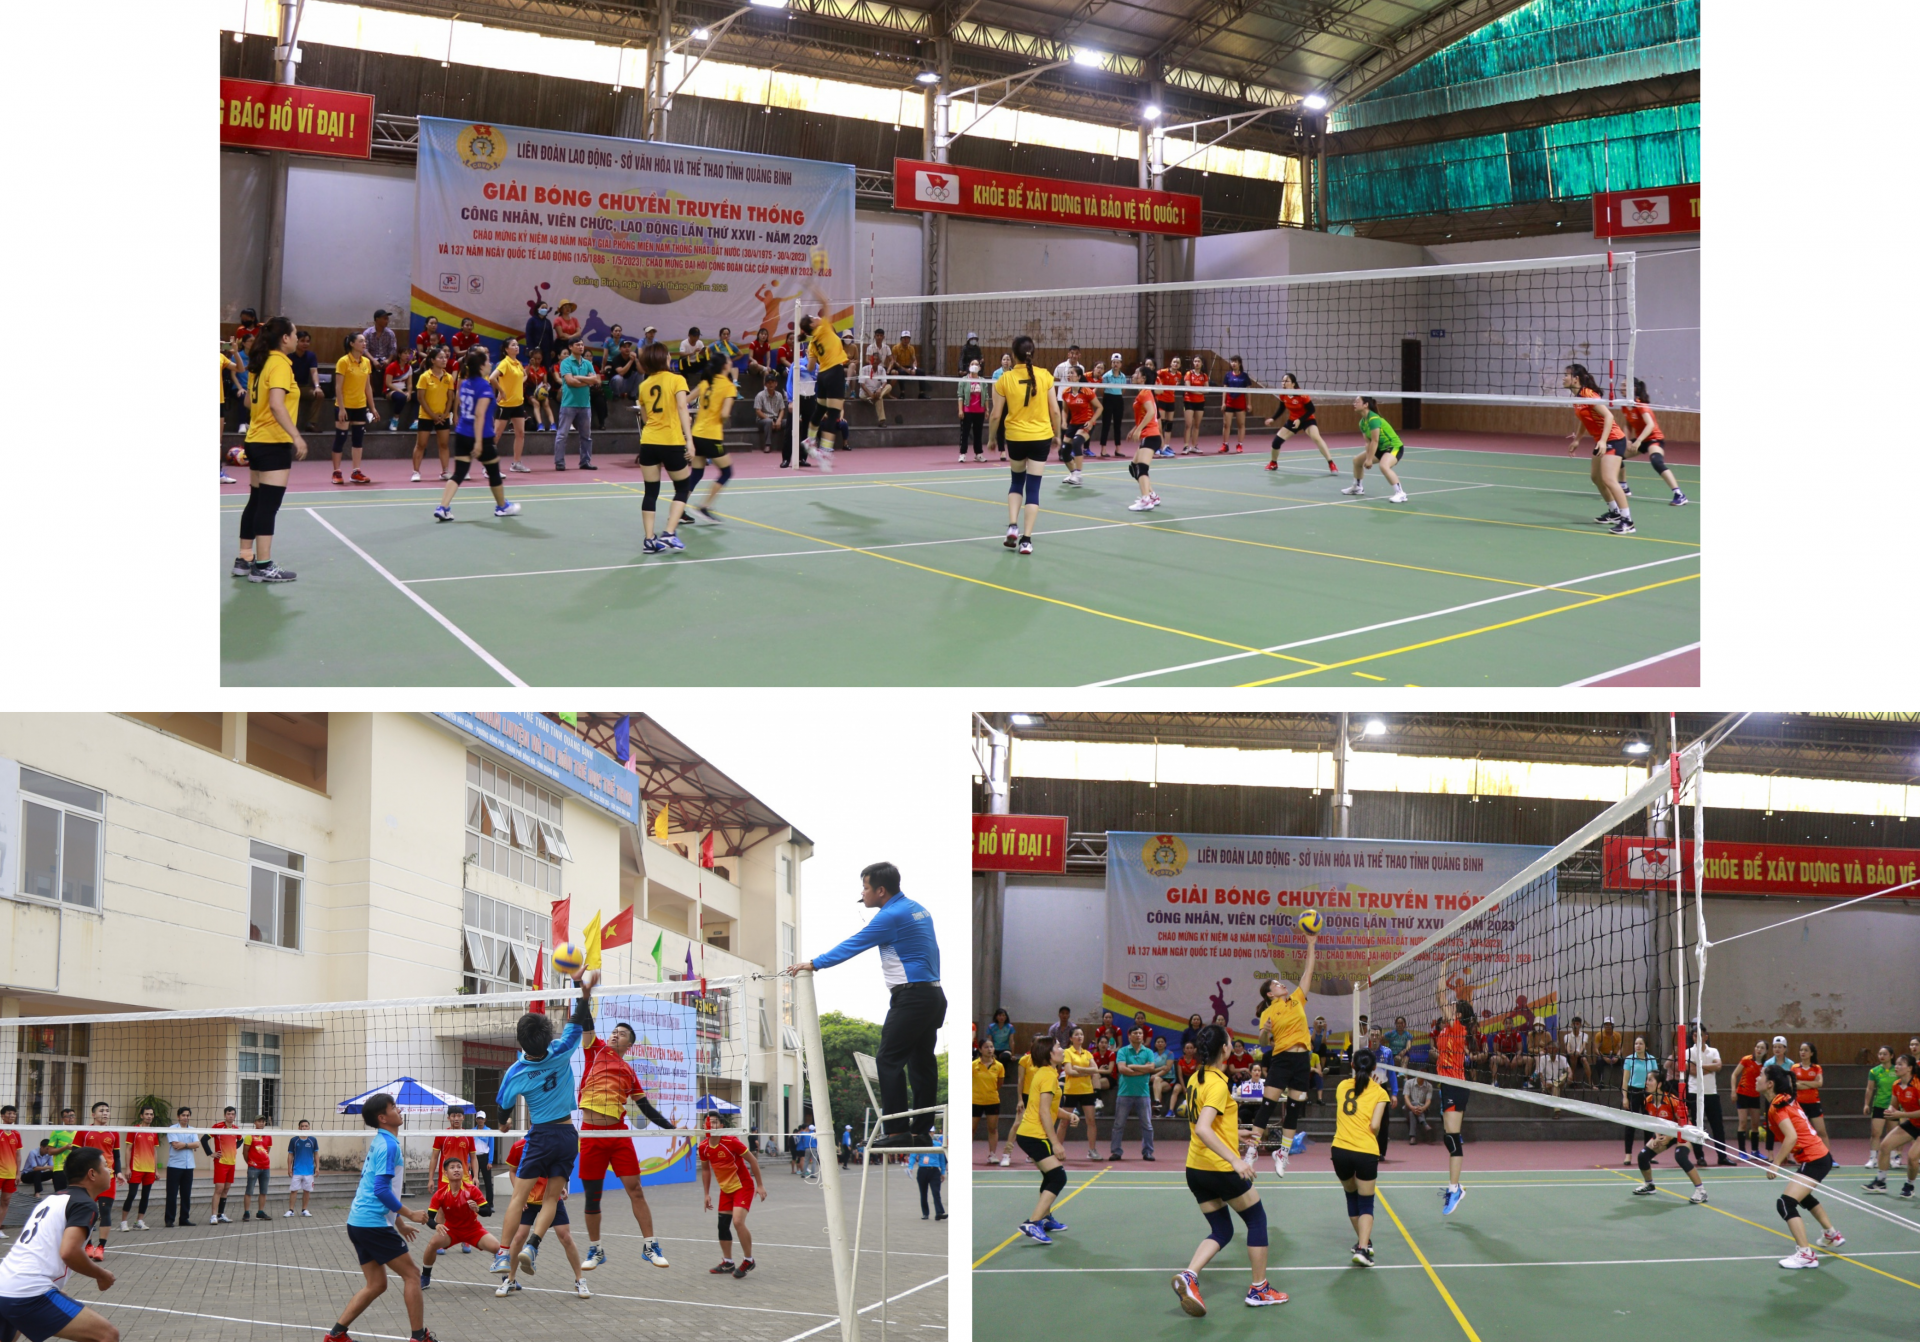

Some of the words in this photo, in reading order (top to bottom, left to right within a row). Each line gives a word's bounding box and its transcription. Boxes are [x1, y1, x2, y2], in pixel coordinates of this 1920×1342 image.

[229, 96, 264, 129] BÁC
[269, 97, 293, 132] HỒ
[298, 103, 314, 134] VĨ
[317, 110, 344, 142] ĐẠI
[517, 141, 538, 160] LIÊN
[540, 143, 566, 163] ĐOÀN
[568, 149, 585, 165] LAO
[588, 148, 612, 169] ĐỘNG
[621, 151, 633, 169] SỞ
[635, 154, 652, 171] VĂN
[654, 155, 671, 174] HÓA
[674, 158, 684, 175] VÀ
[687, 157, 703, 177] THỂ
[704, 163, 723, 179] THAO
[726, 161, 743, 181] TỈNH
[746, 164, 772, 184] QUẢNG
[774, 168, 792, 186] BÌNH
[483, 180, 527, 202] GIẢI
[534, 185, 592, 208] BÓNG
[598, 192, 670, 215] CHUYỀN
[676, 198, 742, 221] TRUYỀN
[747, 203, 805, 226] THỐNG
[973, 180, 1004, 207] KHỎE
[1008, 182, 1024, 209] ĐỂ
[1026, 189, 1048, 211] XÂY
[1051, 194, 1081, 217] DỰNG
[1084, 194, 1098, 216] VÀ
[1101, 194, 1121, 219] BẢO
[1123, 199, 1137, 224] VỆ
[1139, 196, 1151, 221] TỔ
[1153, 201, 1179, 225] QUỐC
[461, 206, 498, 222] CÔNG
[502, 209, 543, 226] NHÂN,
[547, 213, 576, 228] VIÊN
[580, 215, 617, 231] CHỨC,
[621, 220, 642, 234] LAO
[646, 221, 678, 238] ĐỘNG
[707, 226, 729, 240] THỨ
[731, 229, 755, 241] XXVI
[766, 232, 790, 244] NĂM
[793, 234, 818, 246] 2023
[451, 245, 464, 255] 137
[538, 251, 551, 261] LAO
[473, 229, 493, 240] CHÀO
[656, 243, 670, 252] NAM
[650, 385, 663, 413] 2
[1018, 379, 1032, 407] 7
[978, 825, 998, 855] HỒ
[1002, 828, 1016, 855] VĨ
[1018, 833, 1042, 861] ĐẠI
[1197, 846, 1218, 863] LIÊN
[1220, 847, 1245, 864] ĐOÀN
[1246, 850, 1263, 865] LAO
[1265, 848, 1290, 868] ĐỘNG
[1299, 848, 1311, 867] SỞ
[1313, 850, 1331, 867] VĂN
[1333, 850, 1351, 868] HÓA
[1353, 851, 1365, 868] VÀ
[1367, 849, 1384, 869] THỂ
[1385, 854, 1407, 870] THAO
[1409, 852, 1430, 870] TỈNH
[1431, 852, 1461, 871] QUẢNG
[1463, 855, 1484, 872] BÌNH
[1743, 851, 1763, 881] ĐỂ
[1767, 857, 1795, 882] XÂY
[1800, 861, 1840, 887] DỰNG
[1844, 859, 1863, 884] VÀ
[1867, 857, 1895, 885] BẢO
[1899, 861, 1917, 890] VỆ
[1167, 884, 1208, 904] GIẢI
[1215, 886, 1271, 906] BÓNG
[1277, 887, 1352, 908] CHUYỀN
[1358, 888, 1428, 909] TRUYỀN
[1146, 910, 1181, 924] CÔNG
[1185, 911, 1223, 926] NHÂN,
[1228, 912, 1256, 926] VIÊN
[1259, 913, 1296, 928] CHỨC,
[1326, 914, 1359, 929] ĐỘNG
[1391, 915, 1415, 929] THỨ
[1417, 918, 1444, 930] XXVI
[1138, 946, 1150, 956] 137
[1219, 948, 1232, 958] LAO
[1336, 936, 1351, 945] NAM
[1243, 1085, 1250, 1094] 4
[1343, 1088, 1358, 1116] 8
[20, 1206, 50, 1245] 3
